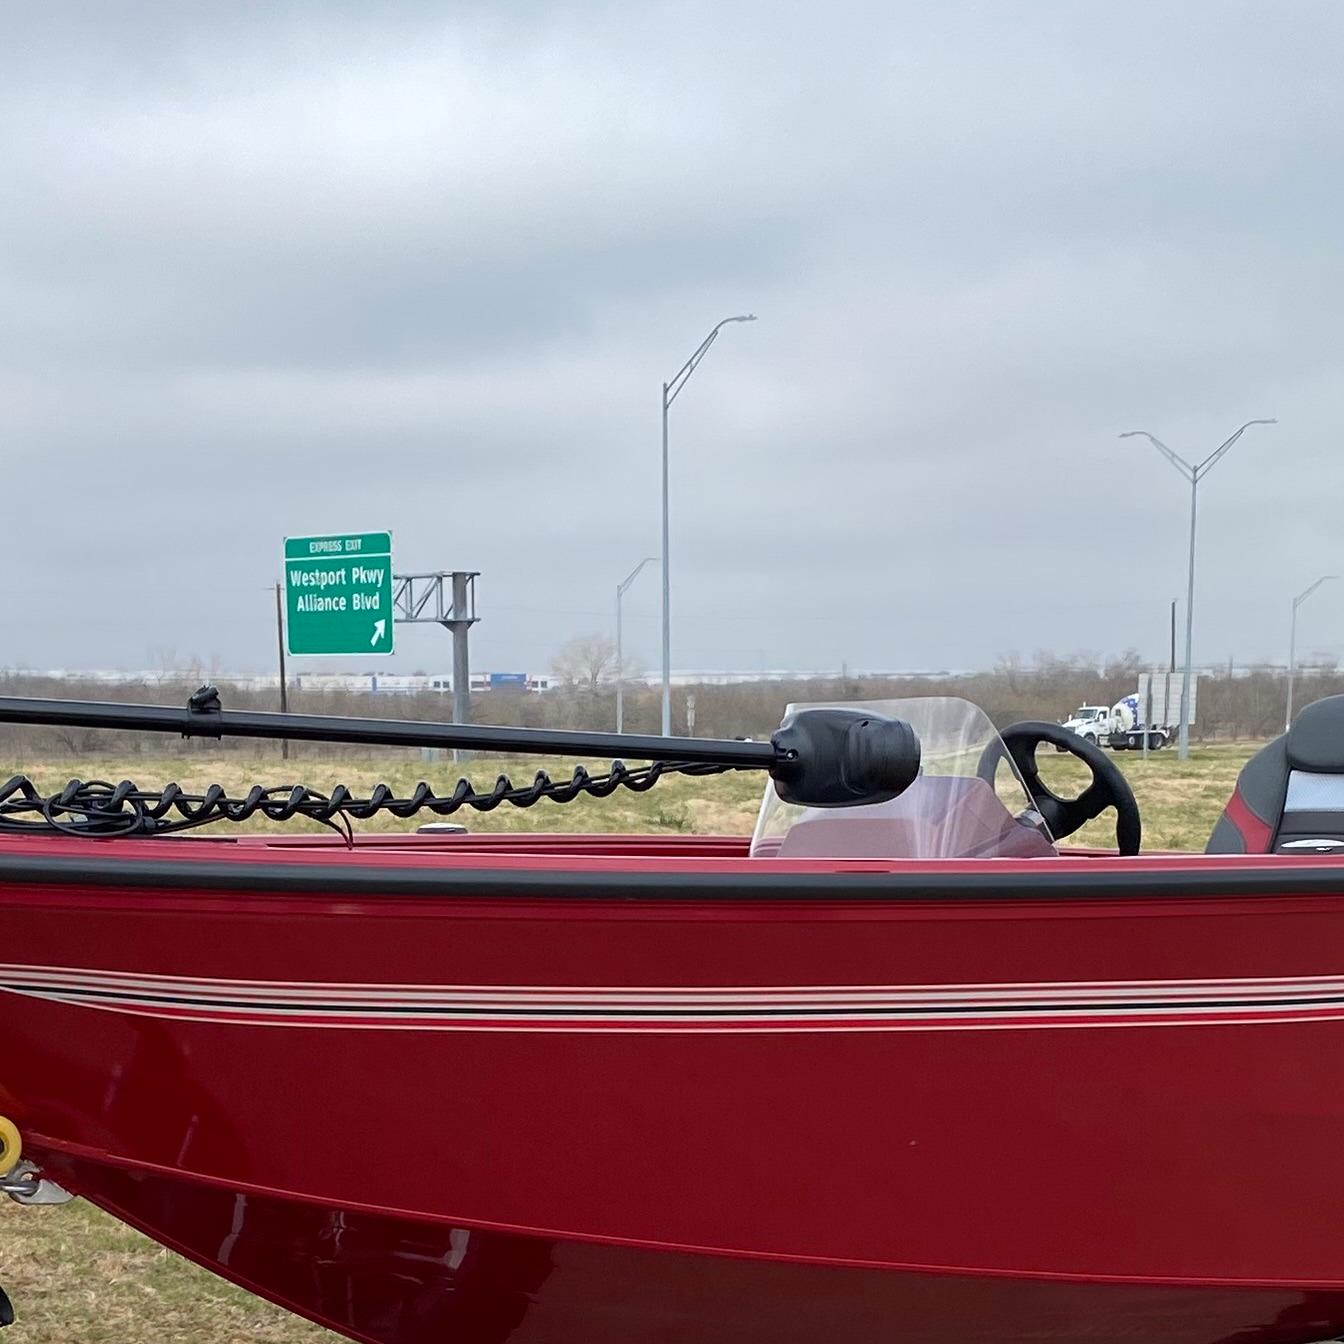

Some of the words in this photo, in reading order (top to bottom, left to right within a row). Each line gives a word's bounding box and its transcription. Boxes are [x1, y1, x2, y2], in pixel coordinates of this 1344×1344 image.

[309, 540, 343, 554] EXPRESS
[345, 538, 362, 551] EXIT
[290, 568, 346, 590] Westport
[352, 566, 384, 587] Pkwy
[297, 593, 346, 612] Alliance
[353, 592, 380, 610] Blvd
